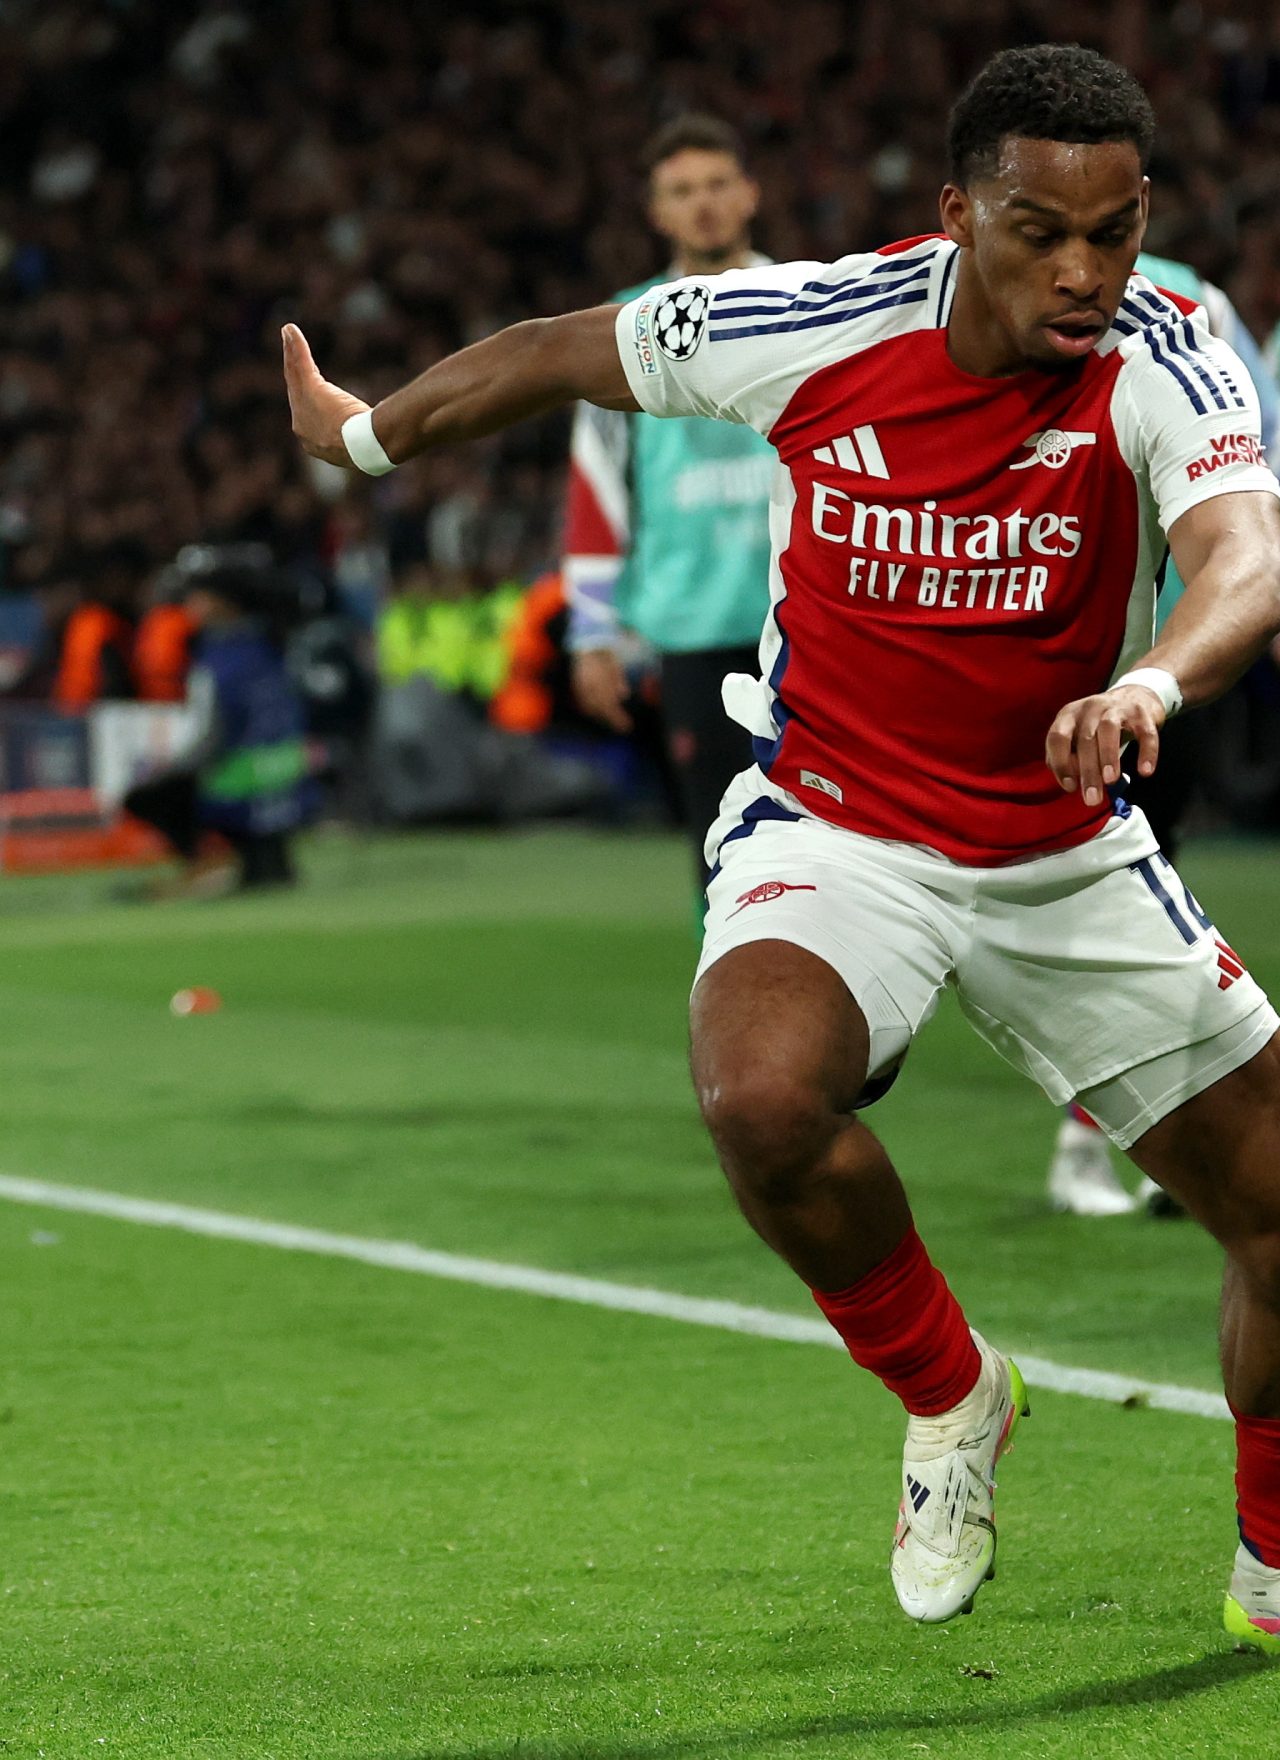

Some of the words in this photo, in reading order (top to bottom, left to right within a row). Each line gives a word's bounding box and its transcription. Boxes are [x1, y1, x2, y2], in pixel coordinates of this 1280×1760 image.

[1209, 433, 1259, 455] VISI
[812, 481, 1082, 560] Emirates
[848, 557, 907, 602] FLY
[917, 565, 1048, 612] BETTER
